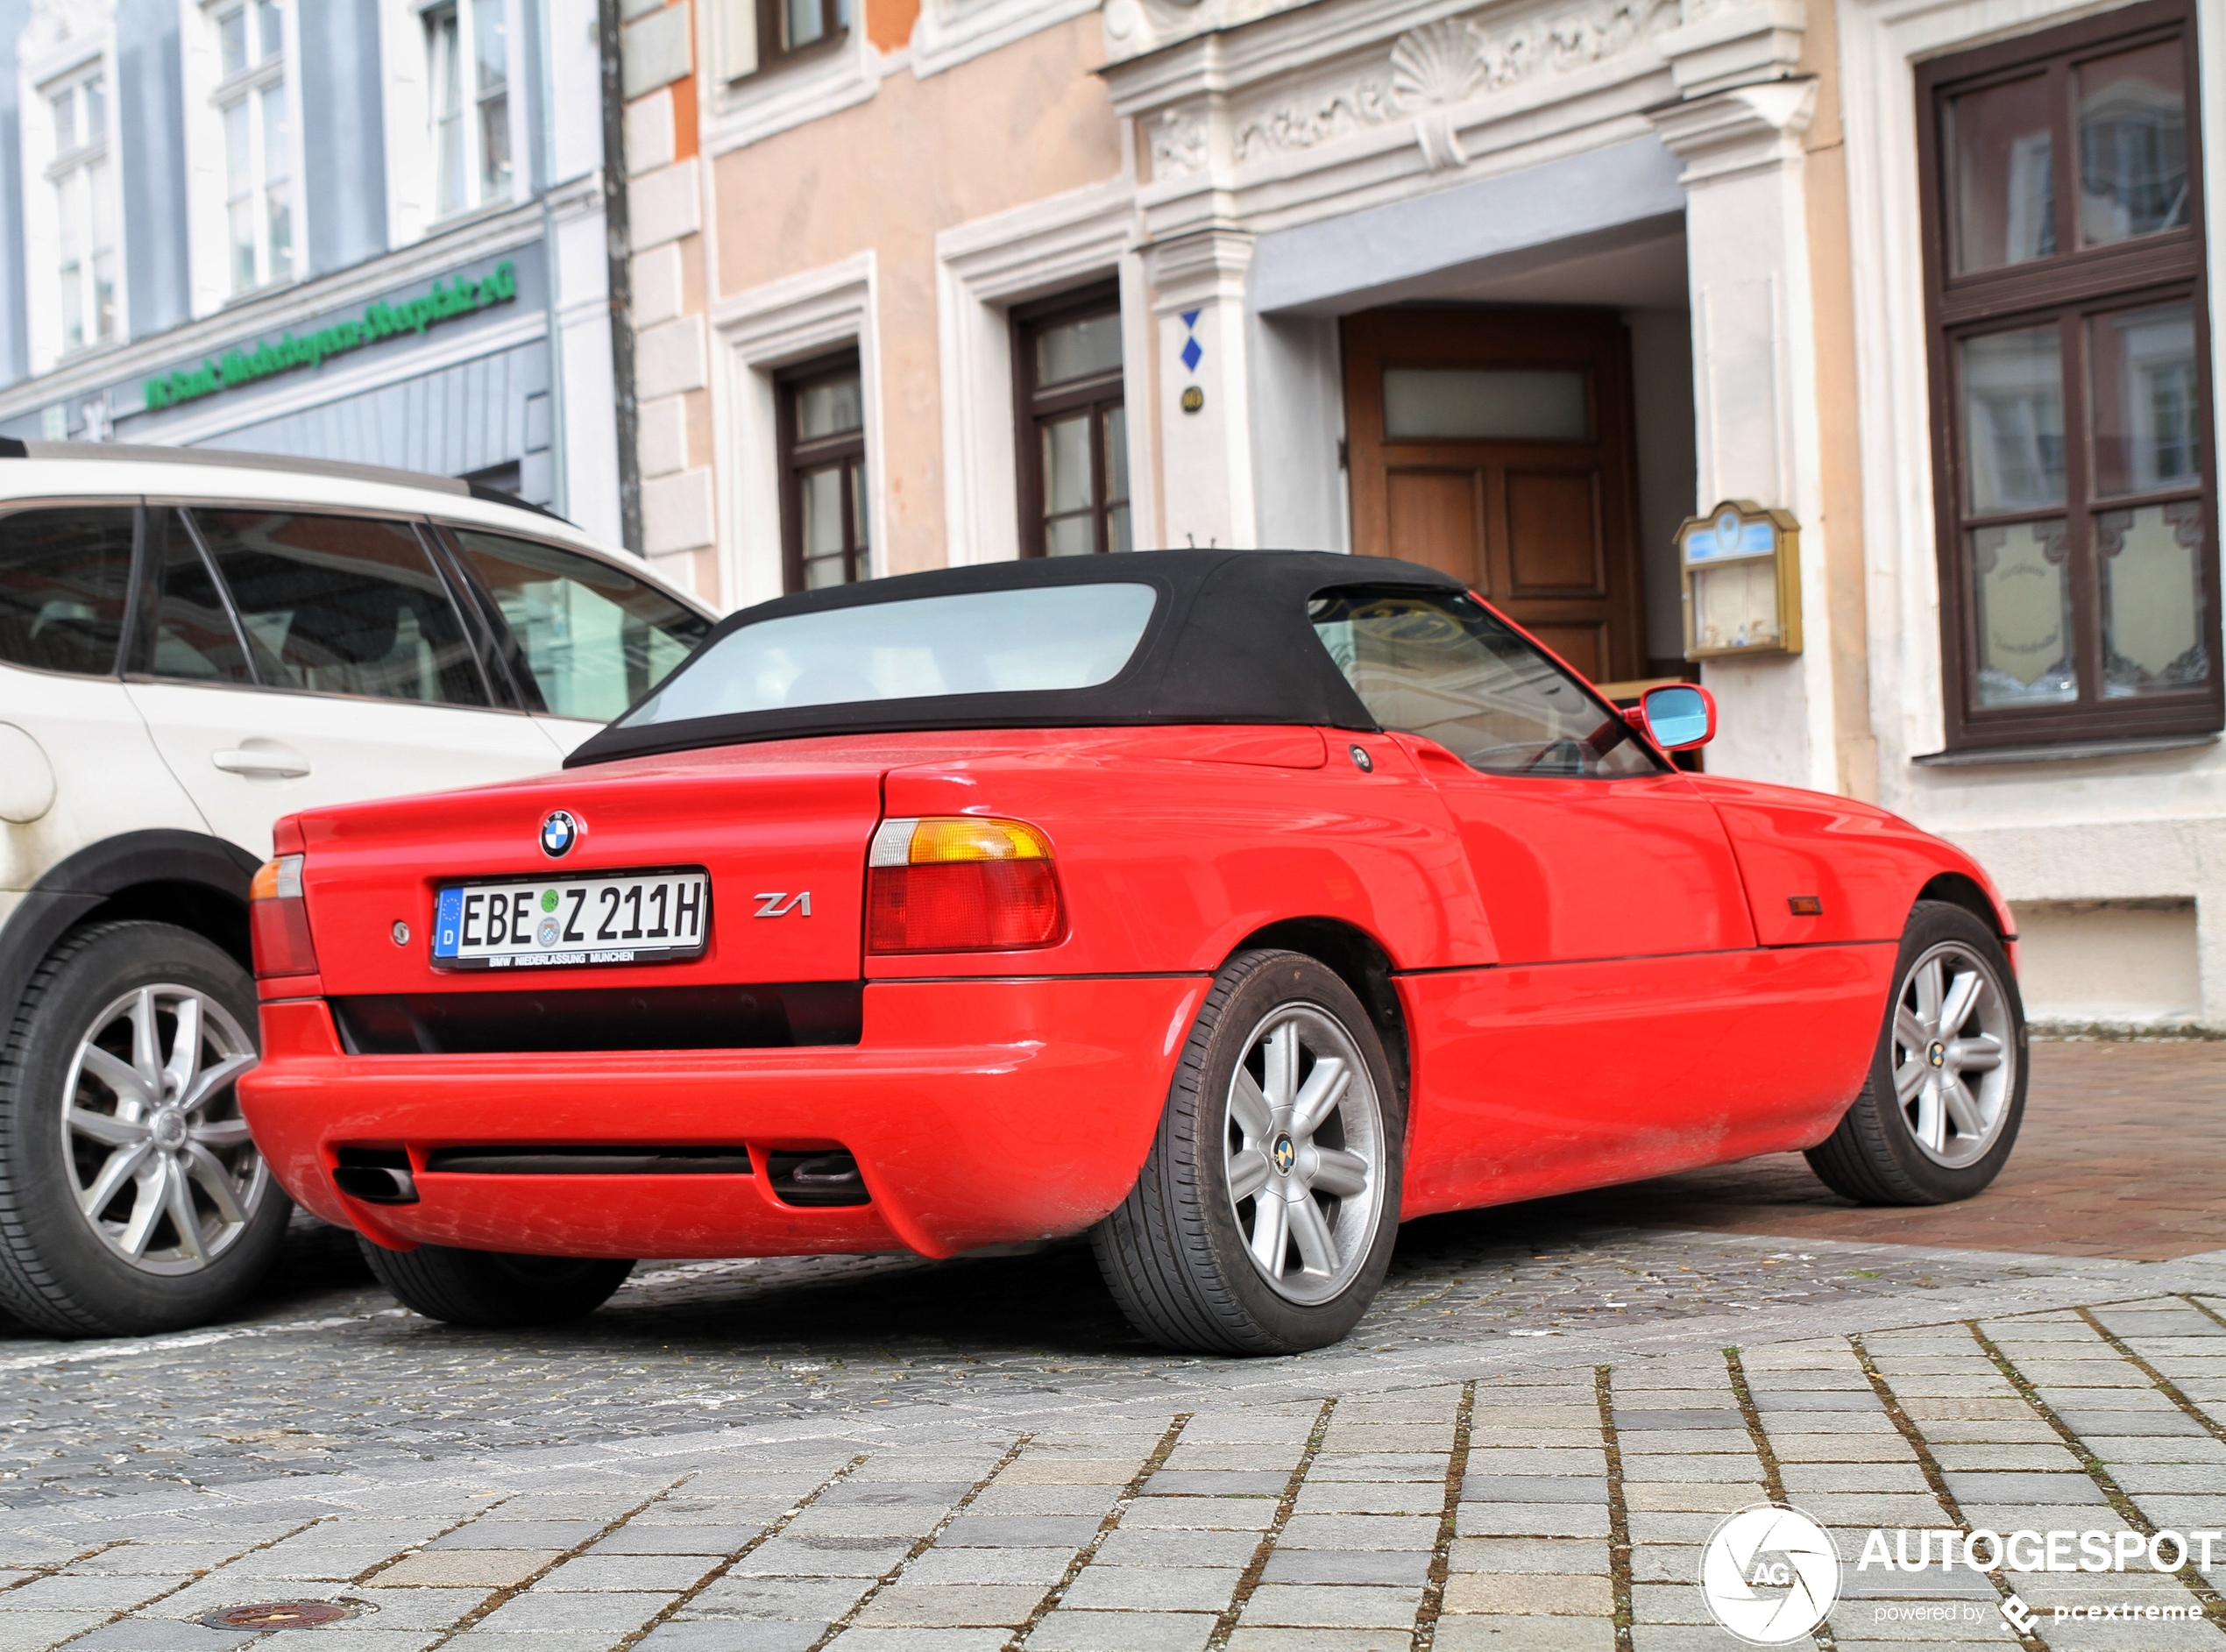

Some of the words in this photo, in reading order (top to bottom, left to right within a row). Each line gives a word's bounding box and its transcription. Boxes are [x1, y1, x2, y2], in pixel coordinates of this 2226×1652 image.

[543, 812, 573, 828] BMW
[443, 930, 454, 946] D
[462, 891, 535, 947] EBE
[563, 889, 586, 942] Z
[597, 882, 701, 940] 211H
[754, 891, 812, 917] Z1
[489, 956, 512, 968] BMW
[514, 954, 586, 967] NIEDERLASSUNG
